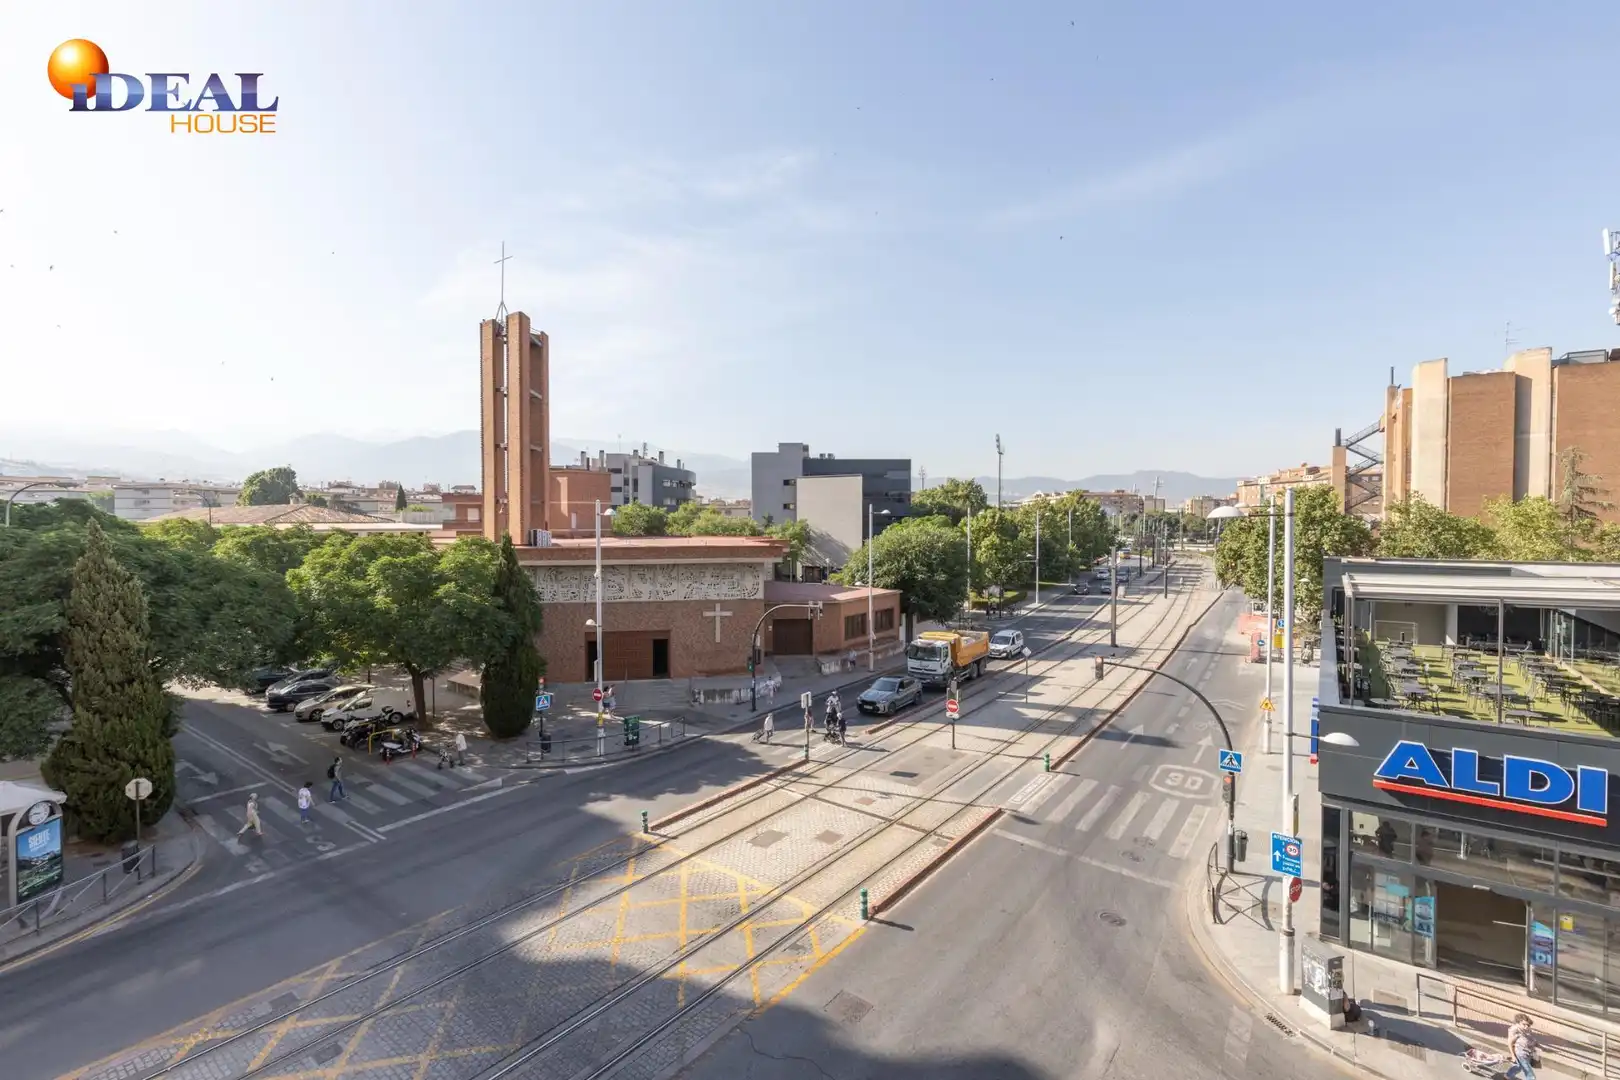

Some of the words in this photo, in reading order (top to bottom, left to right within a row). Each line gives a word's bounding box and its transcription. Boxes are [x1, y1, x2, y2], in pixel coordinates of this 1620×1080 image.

[1164, 771, 1204, 791] 30
[1373, 740, 1608, 815] ALDI
[1290, 883, 1302, 894] STOP
